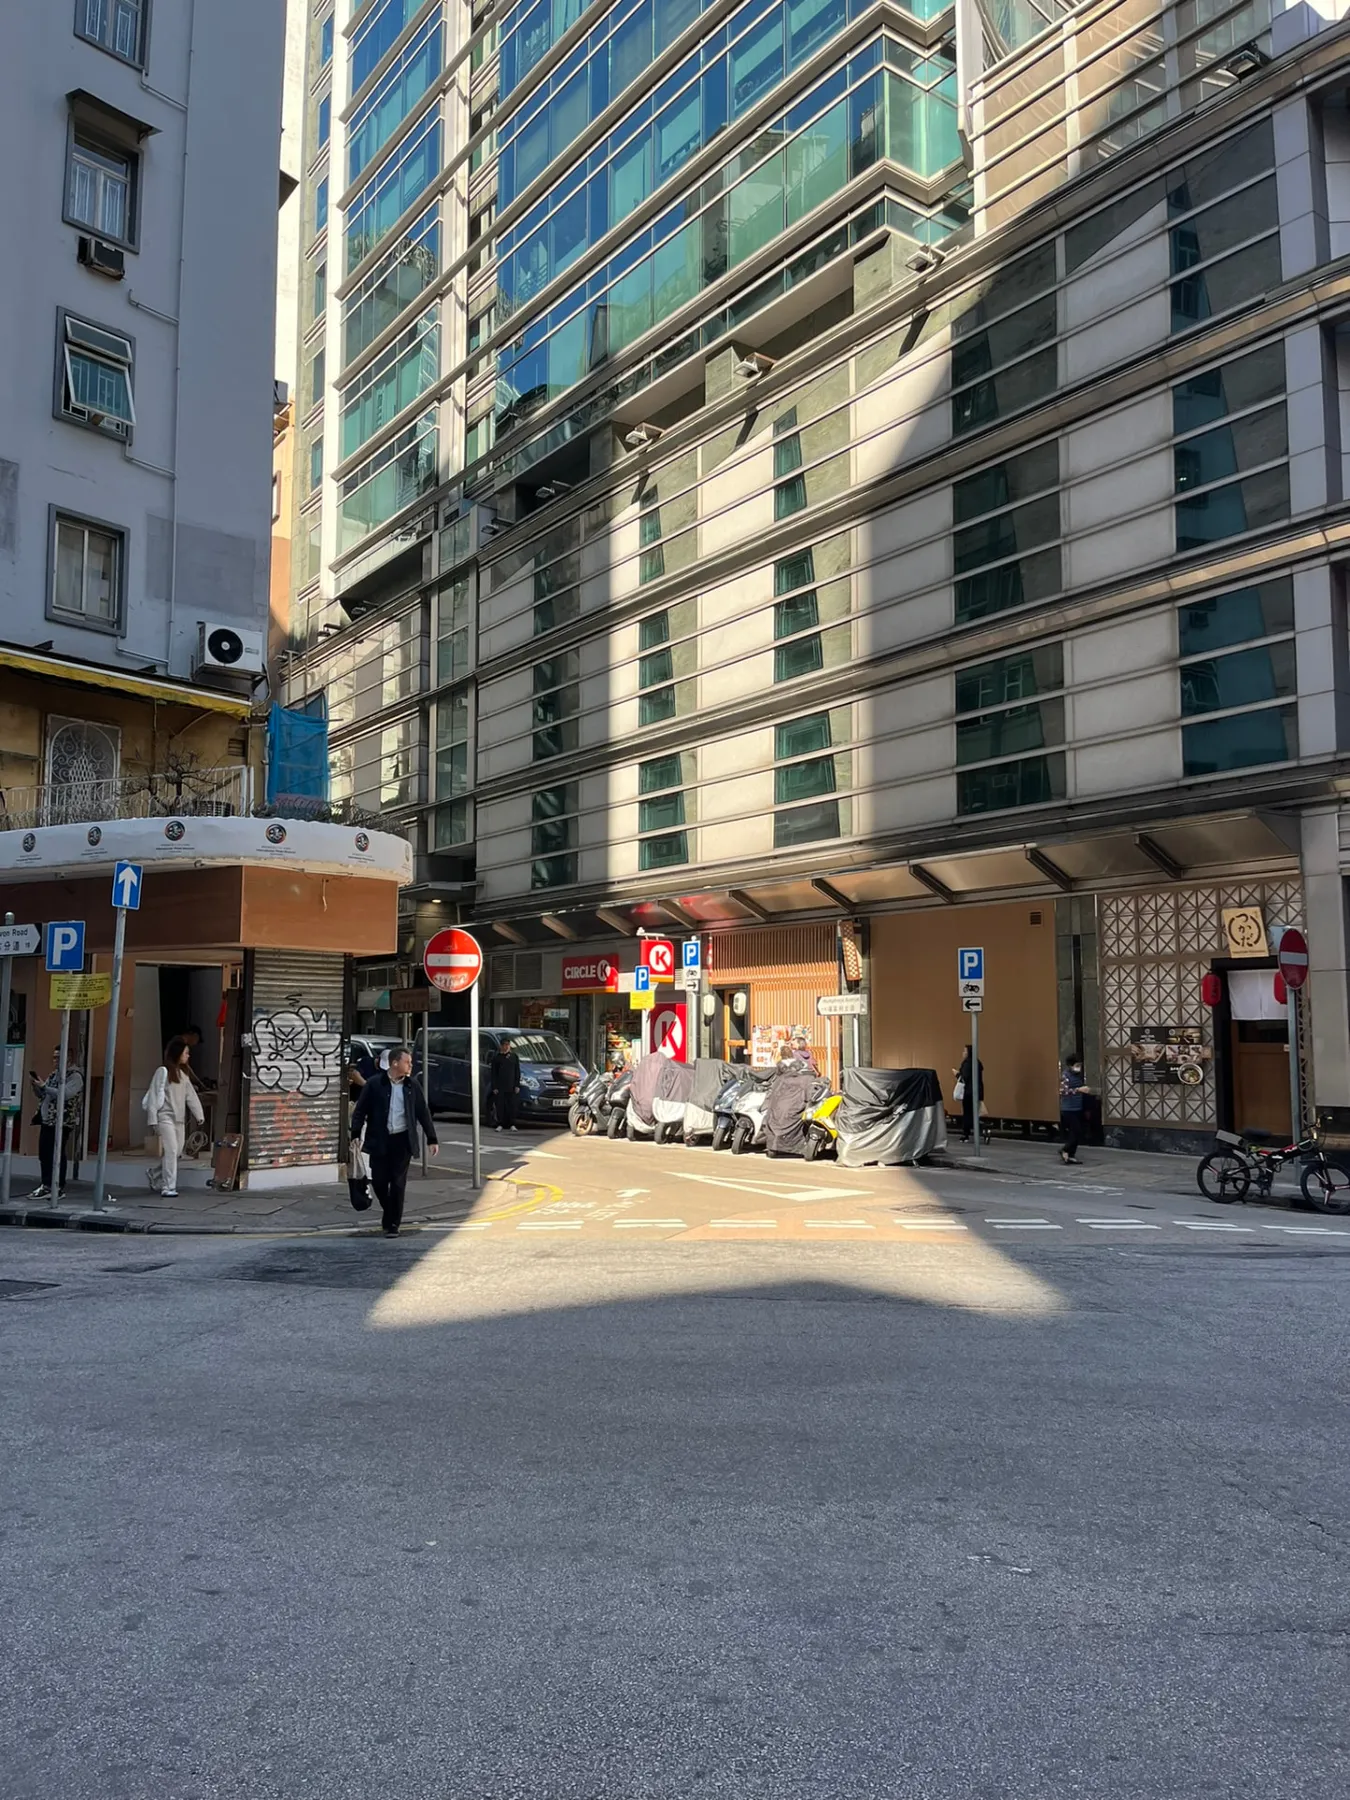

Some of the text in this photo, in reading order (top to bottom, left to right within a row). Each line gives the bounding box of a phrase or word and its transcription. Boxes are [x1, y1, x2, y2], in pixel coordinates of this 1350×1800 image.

[12, 927, 28, 937] Road
[1235, 913, 1253, 947] つかだ
[52, 927, 78, 966] P
[686, 944, 697, 965] P
[564, 961, 610, 980] CIRCLE K
[653, 948, 671, 971] K
[963, 951, 979, 977] P
[638, 968, 648, 989] P
[658, 1016, 681, 1056] K
